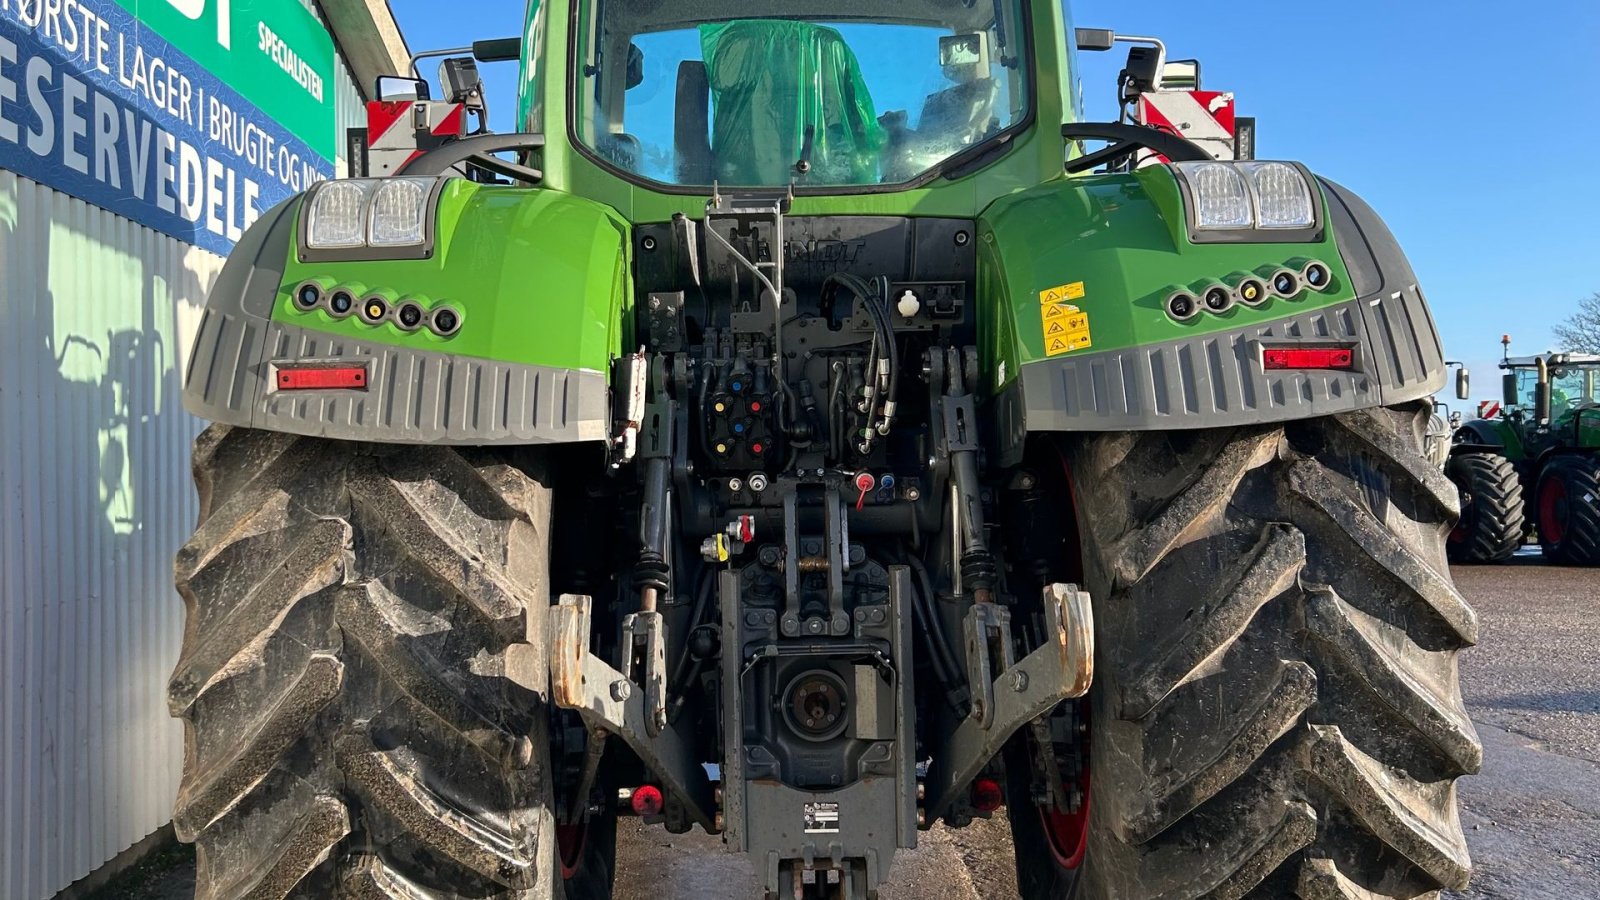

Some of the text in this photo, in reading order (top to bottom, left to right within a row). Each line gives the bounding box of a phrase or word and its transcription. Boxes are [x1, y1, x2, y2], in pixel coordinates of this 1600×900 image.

[119, 32, 193, 126] LAGER
[199, 87, 203, 132] I
[210, 95, 275, 177] BRUGTE
[279, 145, 300, 192] OG
[258, 20, 323, 104] SPECIALISTEN
